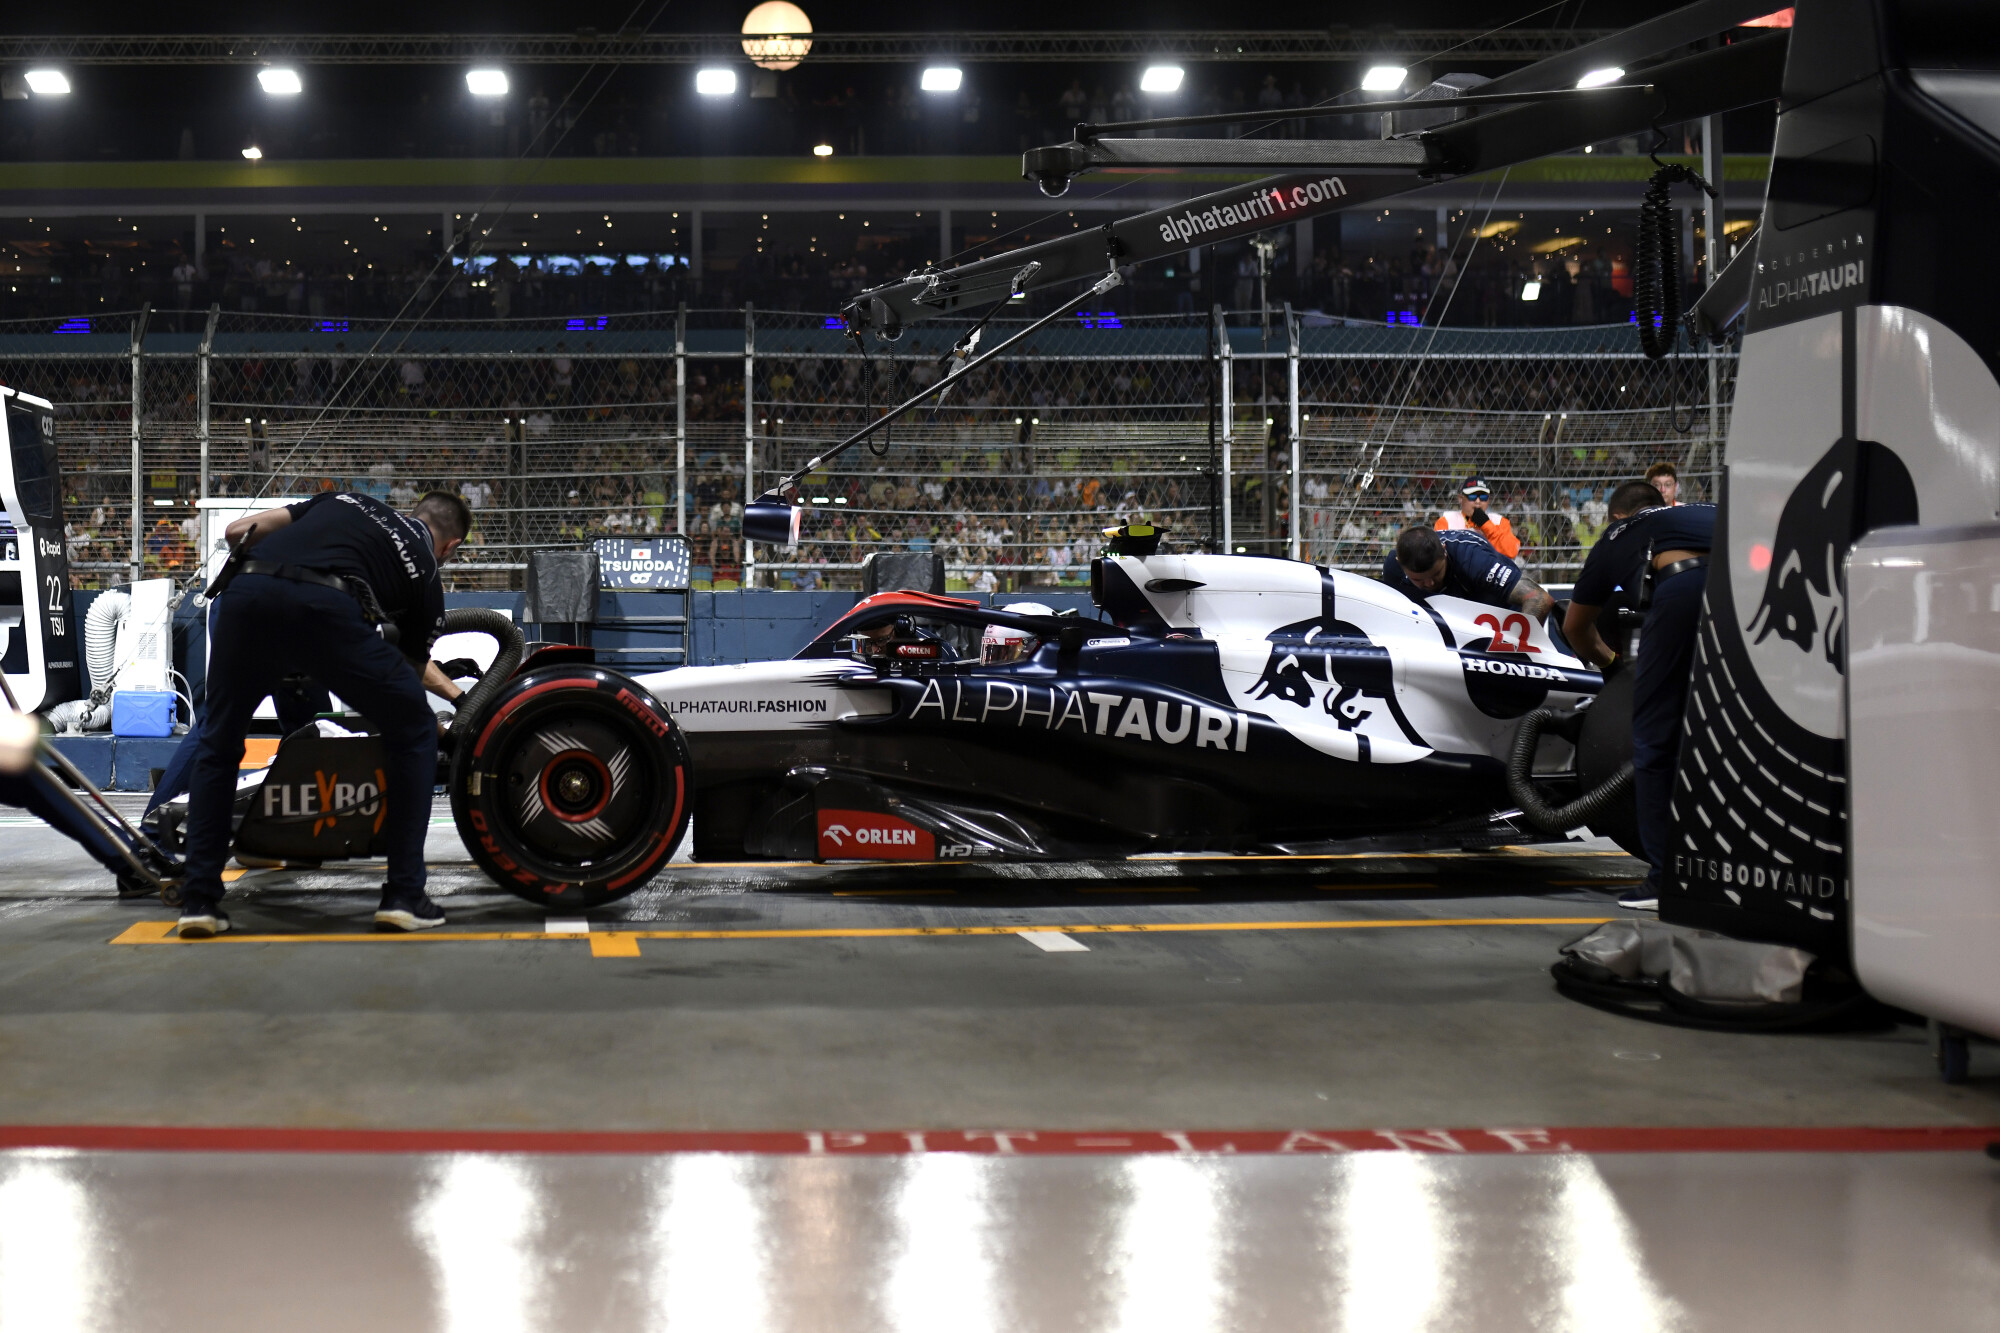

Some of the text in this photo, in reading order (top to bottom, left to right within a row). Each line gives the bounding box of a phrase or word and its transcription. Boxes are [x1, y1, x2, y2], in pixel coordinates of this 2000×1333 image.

[1159, 176, 1348, 243] alphataurif1.com
[1757, 233, 1864, 274] SCUDERIA
[1758, 260, 1865, 311] ALPHATAURI
[46, 541, 61, 557] Rapid
[603, 560, 675, 572] TSUNODA
[46, 575, 63, 611] 22
[50, 617, 65, 636] TSU
[1473, 613, 1542, 654] 22
[907, 647, 931, 655] ORLEN
[1463, 657, 1569, 682] HONDA
[909, 678, 1249, 753] ALPHATAURI
[855, 828, 916, 846] ORLEN
